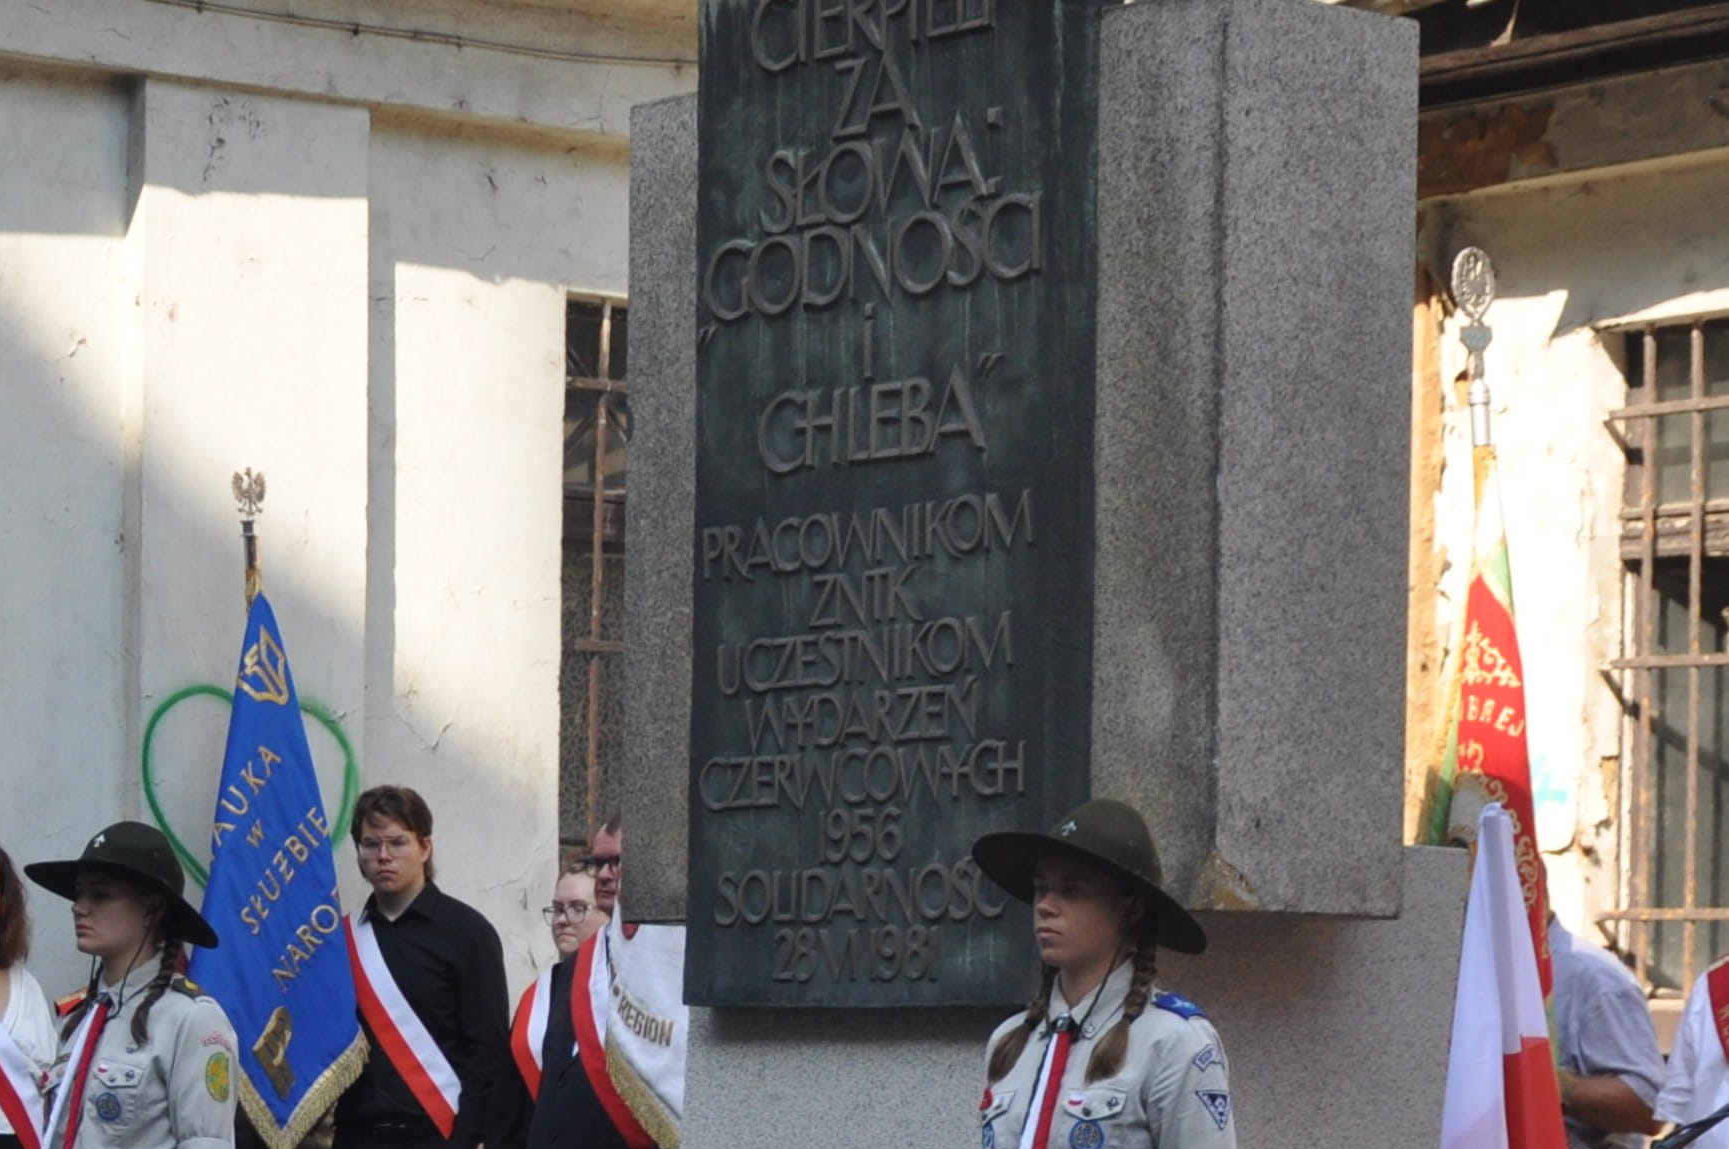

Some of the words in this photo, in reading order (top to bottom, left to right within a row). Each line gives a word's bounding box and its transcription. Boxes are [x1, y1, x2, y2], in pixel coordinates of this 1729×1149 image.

[831, 52, 921, 140] ZA
[702, 488, 1035, 583] PRACOWNIKOM
[808, 563, 925, 629] ZNTK
[716, 611, 1017, 696] UCZESTNIKOM
[744, 675, 980, 752] WYDARZEŃ
[210, 745, 282, 865] AUKA
[698, 740, 1027, 811] CZERWCOWYCH
[820, 807, 904, 865] 1956
[272, 886, 341, 994] NARO
[771, 926, 818, 984] 28
[870, 922, 940, 984] 1981
[617, 994, 675, 1048] REGION
